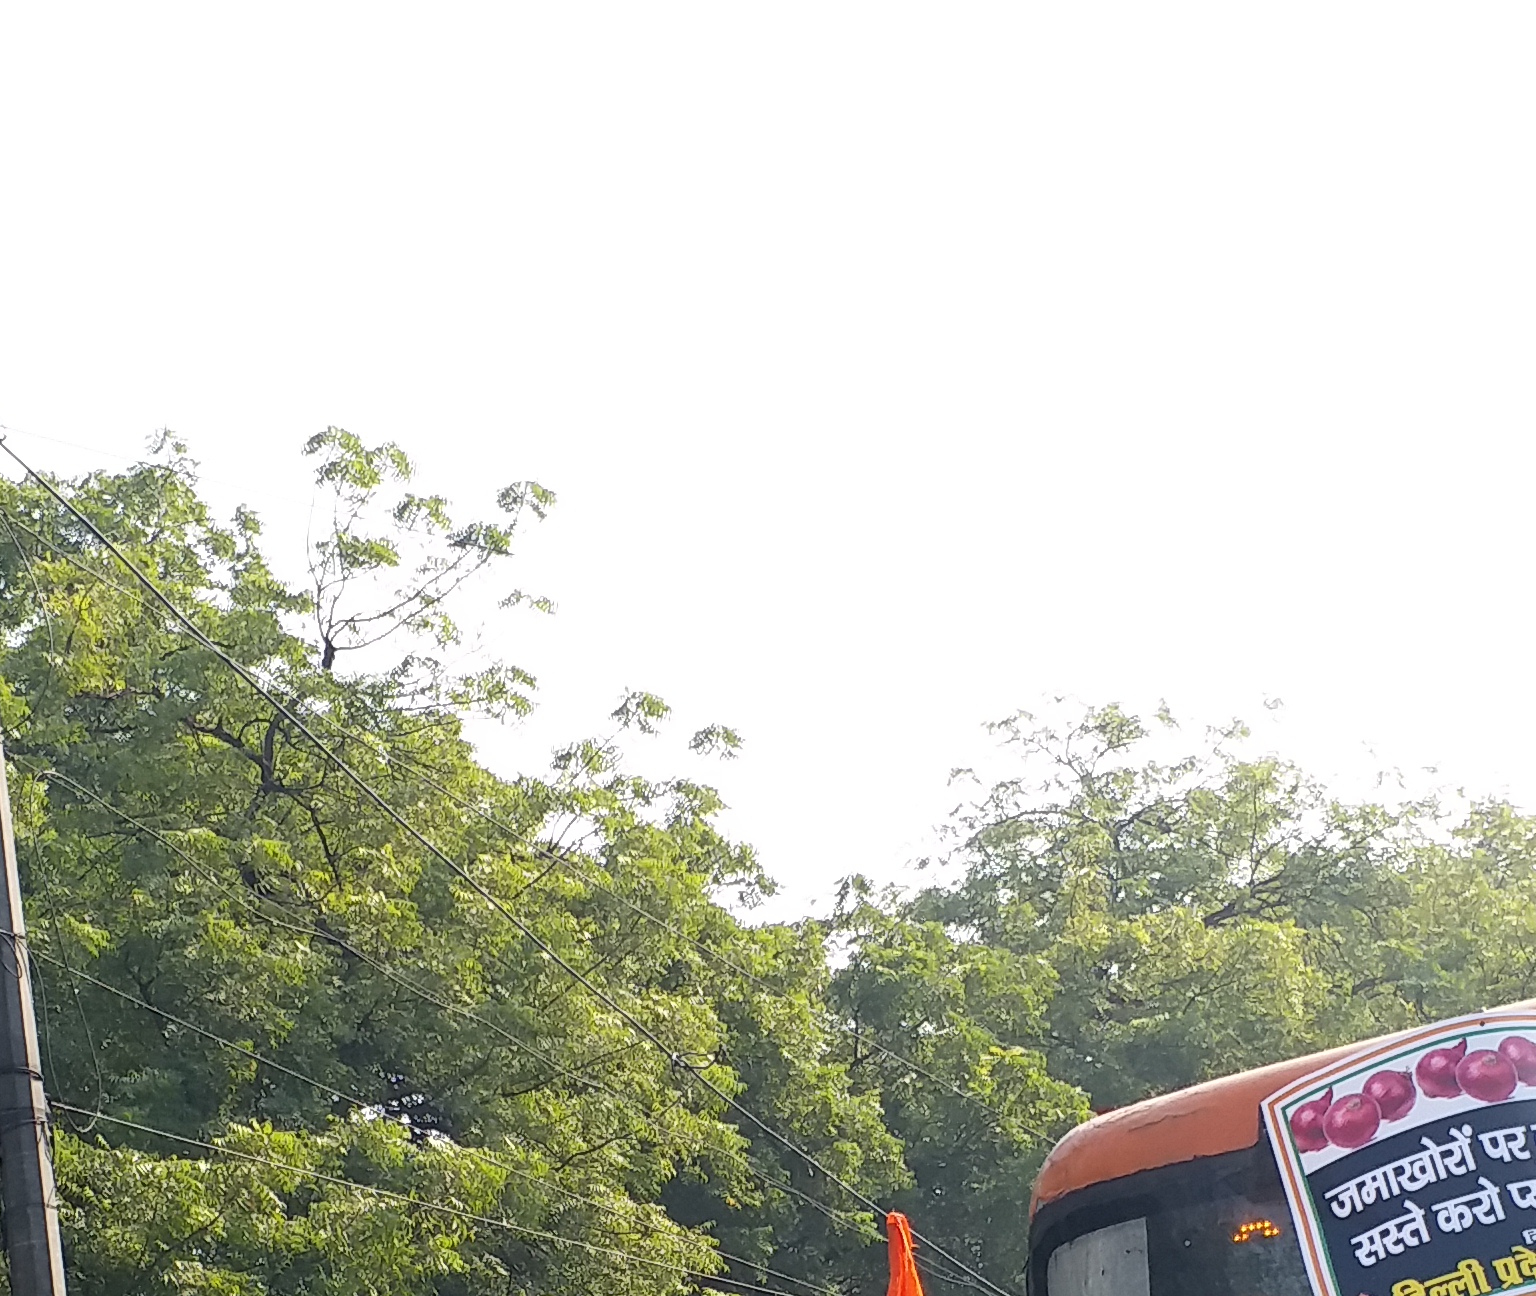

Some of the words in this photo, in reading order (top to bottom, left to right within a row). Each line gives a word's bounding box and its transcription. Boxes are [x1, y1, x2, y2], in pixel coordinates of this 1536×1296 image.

[1324, 1124, 1476, 1220] जमाखोरों
[1478, 1124, 1531, 1163] पर
[1350, 1200, 1431, 1268] सस्ते
[1432, 1176, 1507, 1233] करो
